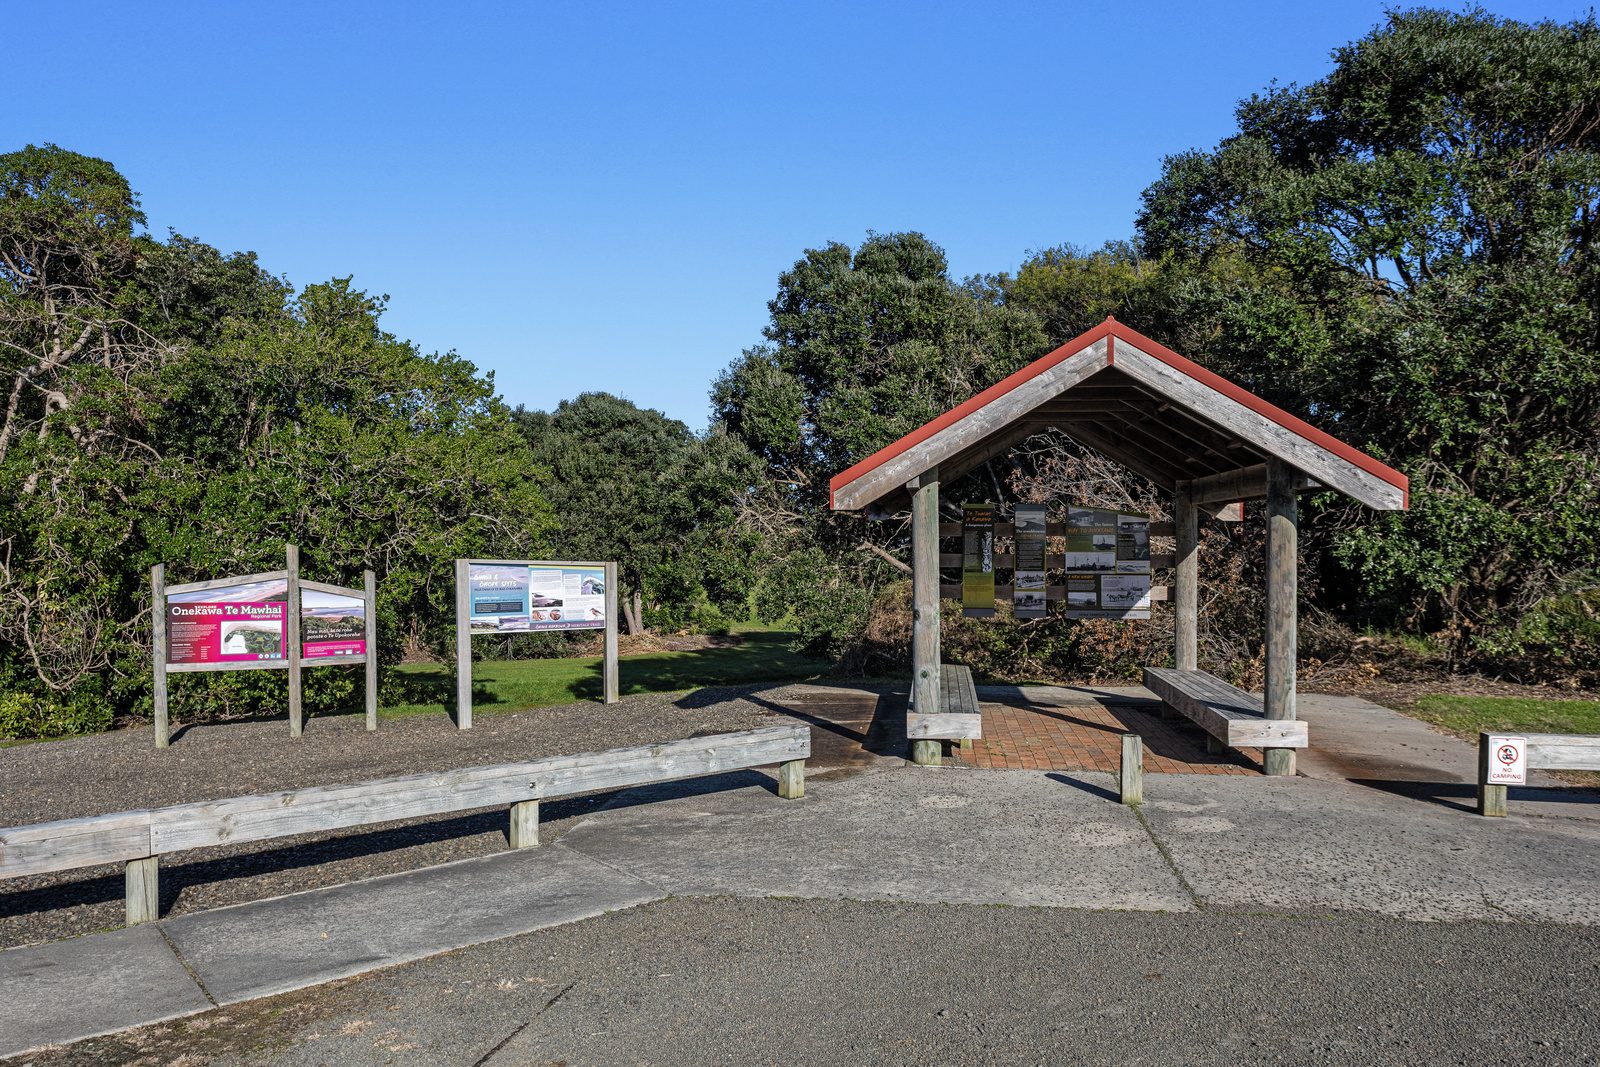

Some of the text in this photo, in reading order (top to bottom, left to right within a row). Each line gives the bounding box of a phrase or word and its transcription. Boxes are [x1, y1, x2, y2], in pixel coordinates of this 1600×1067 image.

[171, 604, 282, 616] Onekawa Te Mawhai
